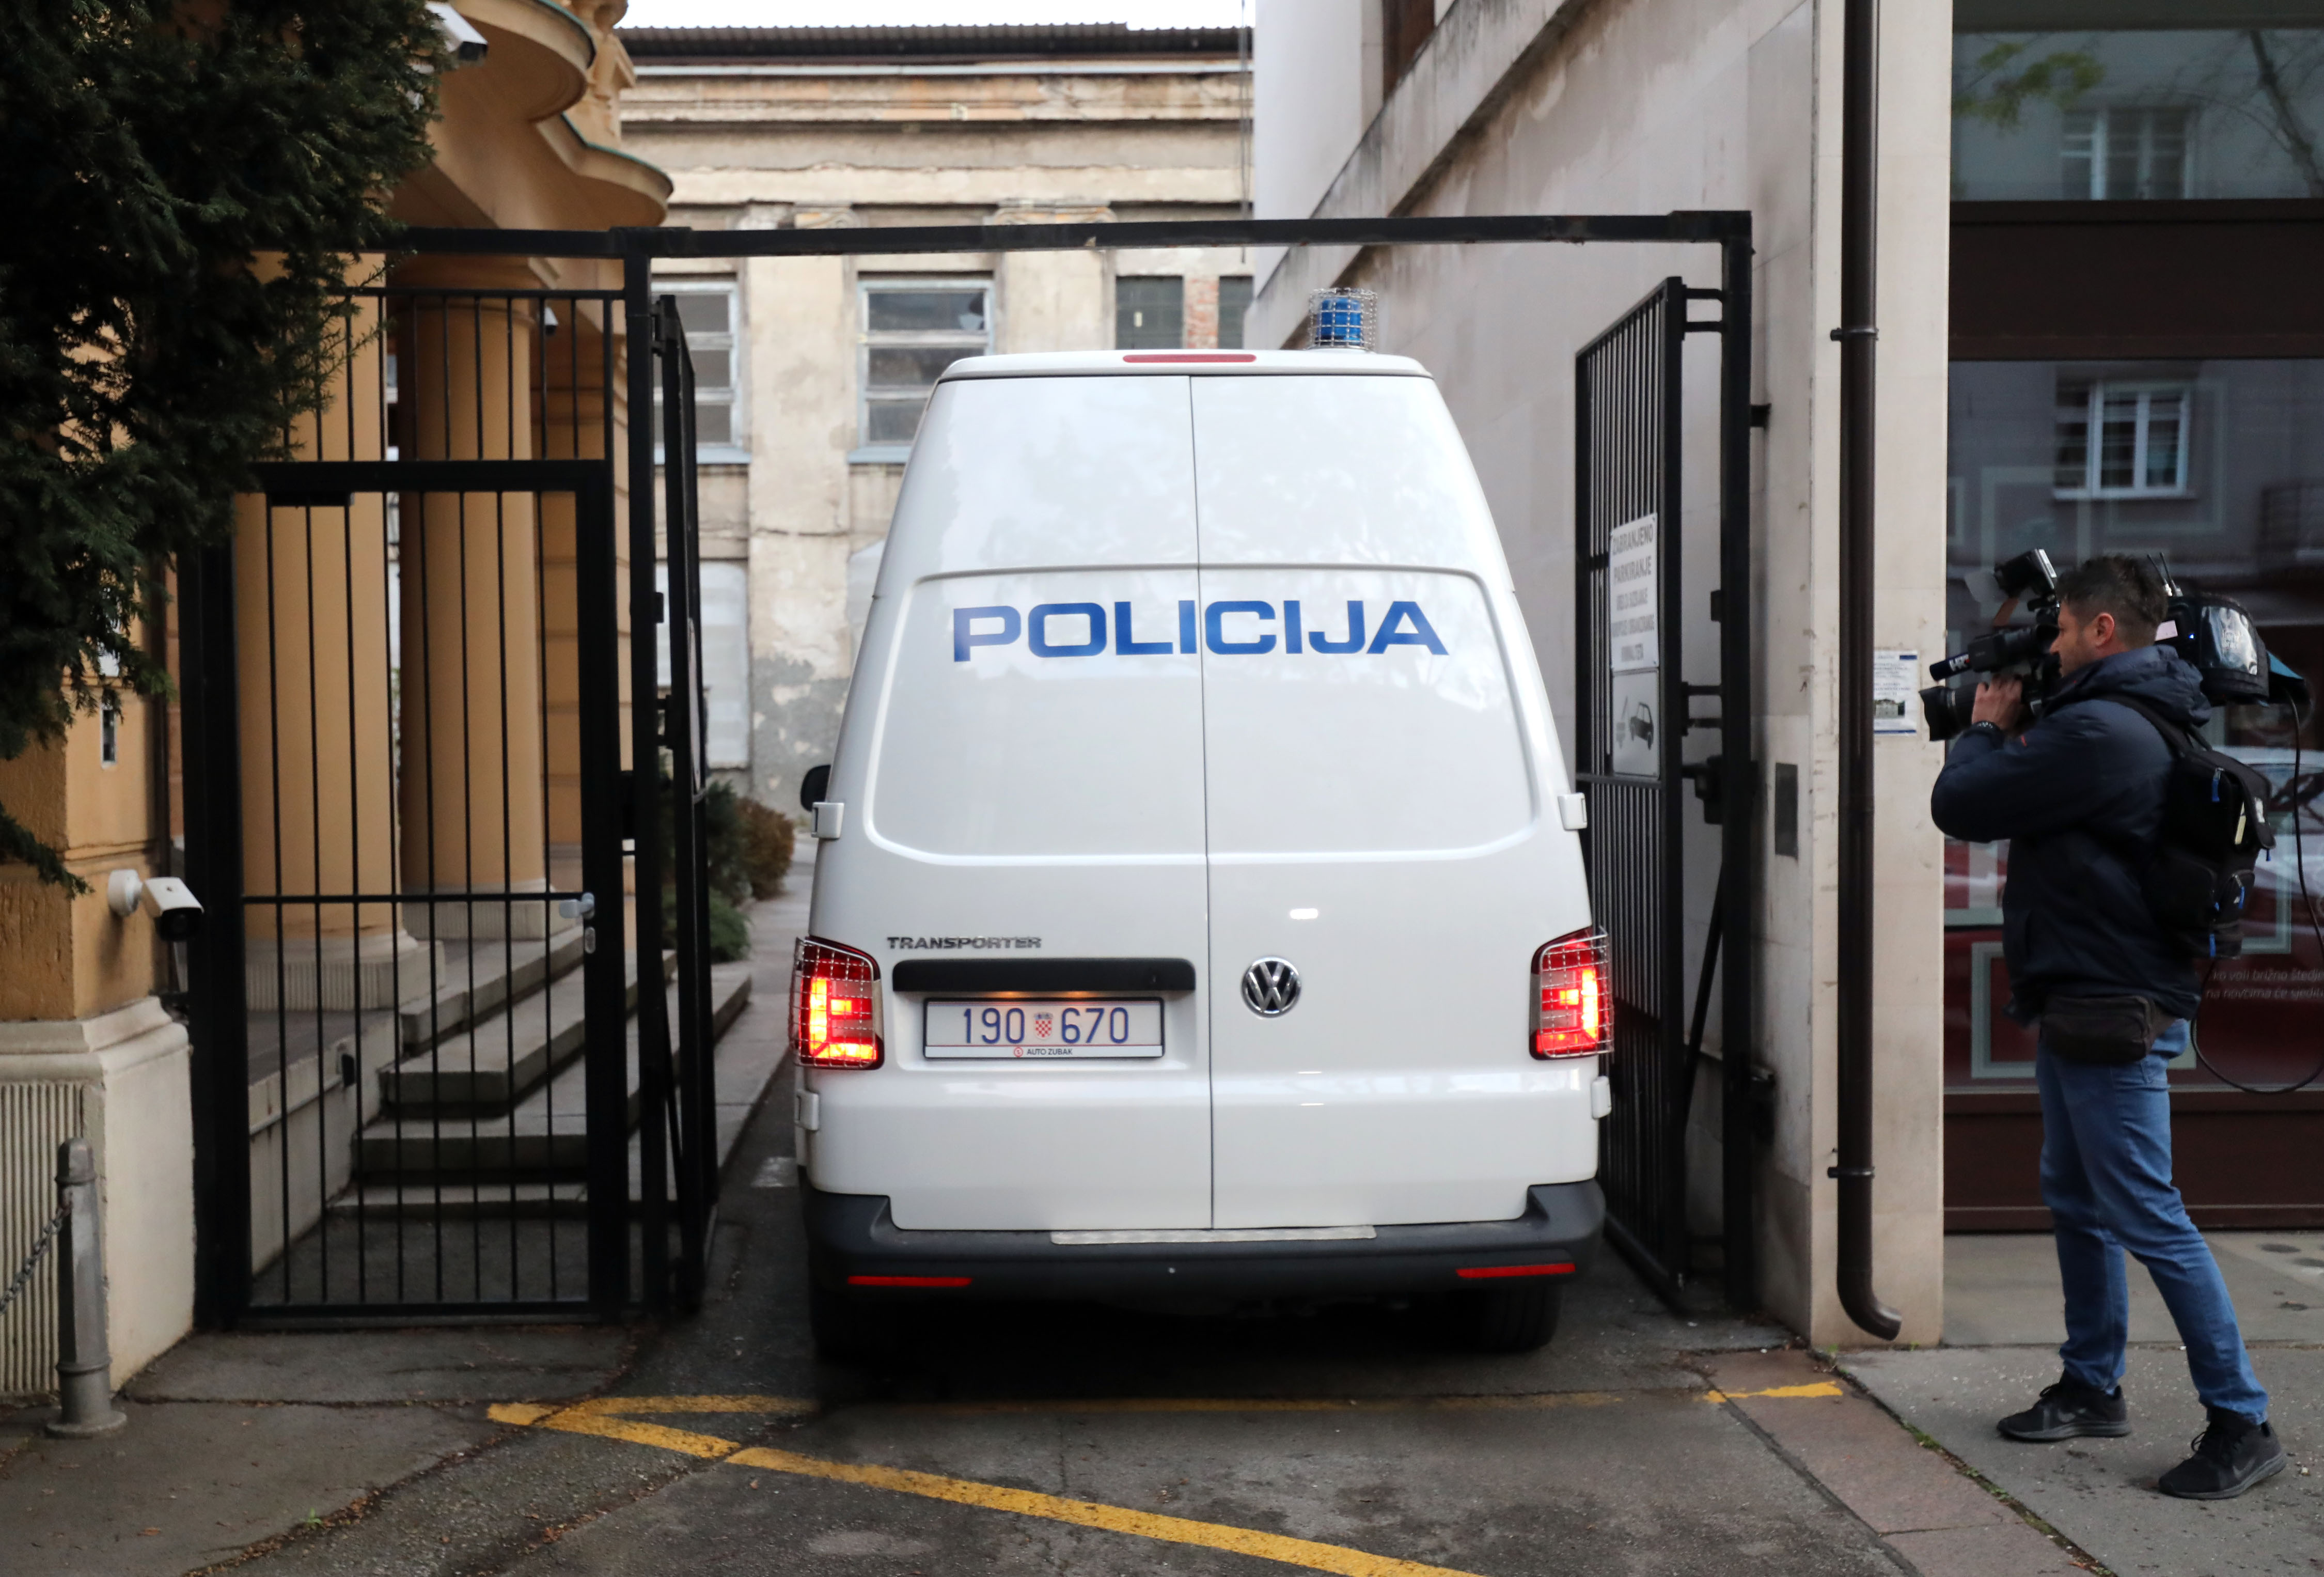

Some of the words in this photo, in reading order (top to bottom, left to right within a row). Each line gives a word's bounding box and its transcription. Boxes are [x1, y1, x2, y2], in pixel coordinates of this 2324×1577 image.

[1614, 555, 1652, 583] PARKIRANJE
[954, 600, 1449, 662] POLICIJA
[887, 936, 1042, 949] TRANSPORTER
[2229, 970, 2249, 981] voli
[2206, 990, 2220, 999] na
[964, 1007, 1025, 1044] 190
[1061, 1007, 1129, 1044] 670
